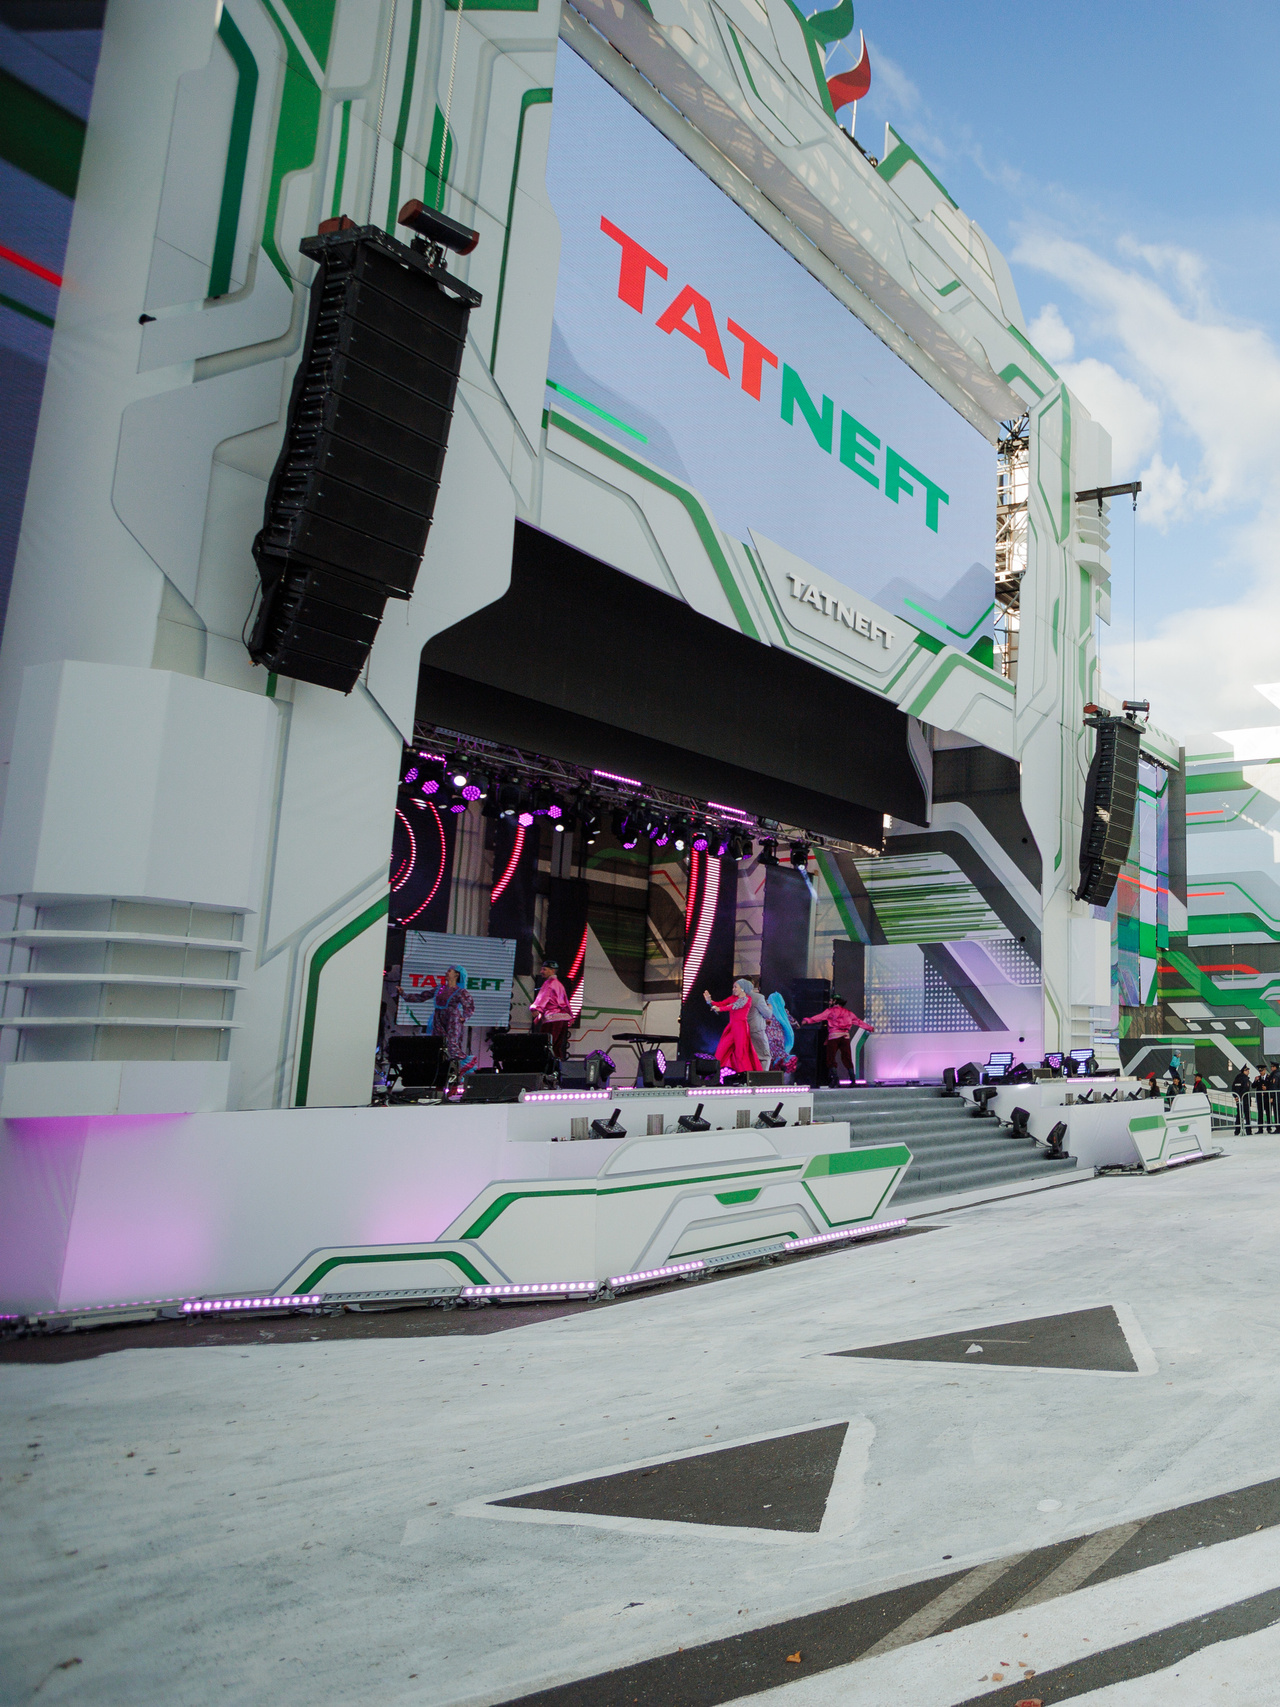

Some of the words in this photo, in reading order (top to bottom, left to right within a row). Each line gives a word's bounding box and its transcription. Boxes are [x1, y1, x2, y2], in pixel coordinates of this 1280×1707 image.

[600, 215, 949, 534] TATNEFT
[786, 572, 895, 649] TATNEFT
[409, 973, 504, 991] TATEFT
